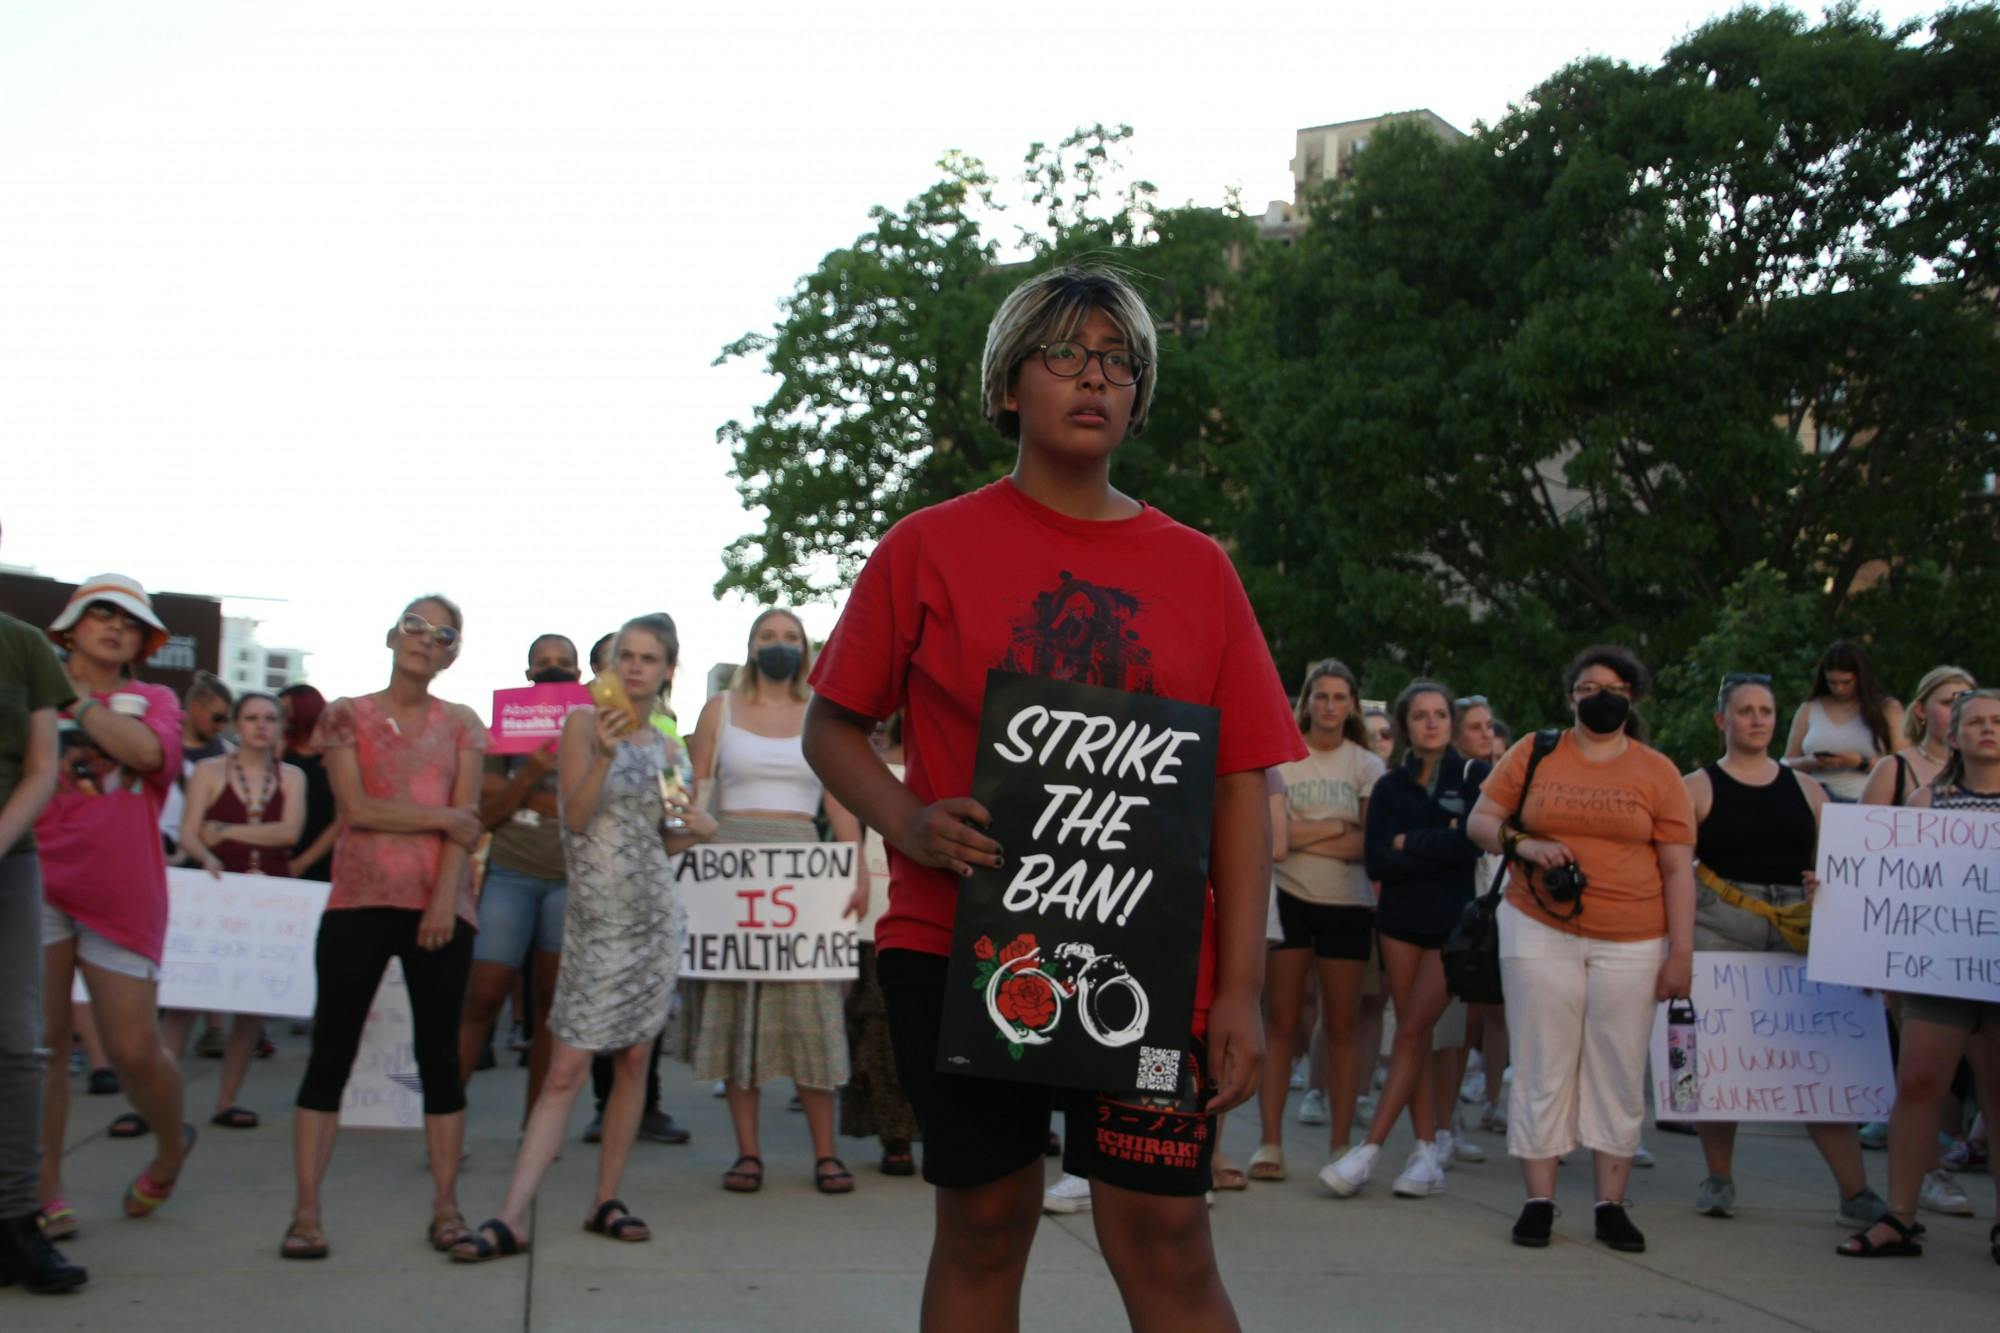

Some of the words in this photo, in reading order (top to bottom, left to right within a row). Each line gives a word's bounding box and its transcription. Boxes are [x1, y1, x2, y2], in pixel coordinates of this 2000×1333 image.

[993, 705, 1200, 785] STRIKE
[1032, 784, 1150, 850] THE
[675, 847, 853, 882] ABORTION
[1827, 854, 1865, 888] MY
[1878, 856, 1943, 890] MOM
[736, 884, 798, 928] IS
[1003, 854, 1153, 927] BAN!
[683, 931, 859, 971] HEALTHCARE
[1886, 951, 1941, 980] FOR
[1713, 963, 1750, 1001] MY
[1792, 1082, 1821, 1115] IT
